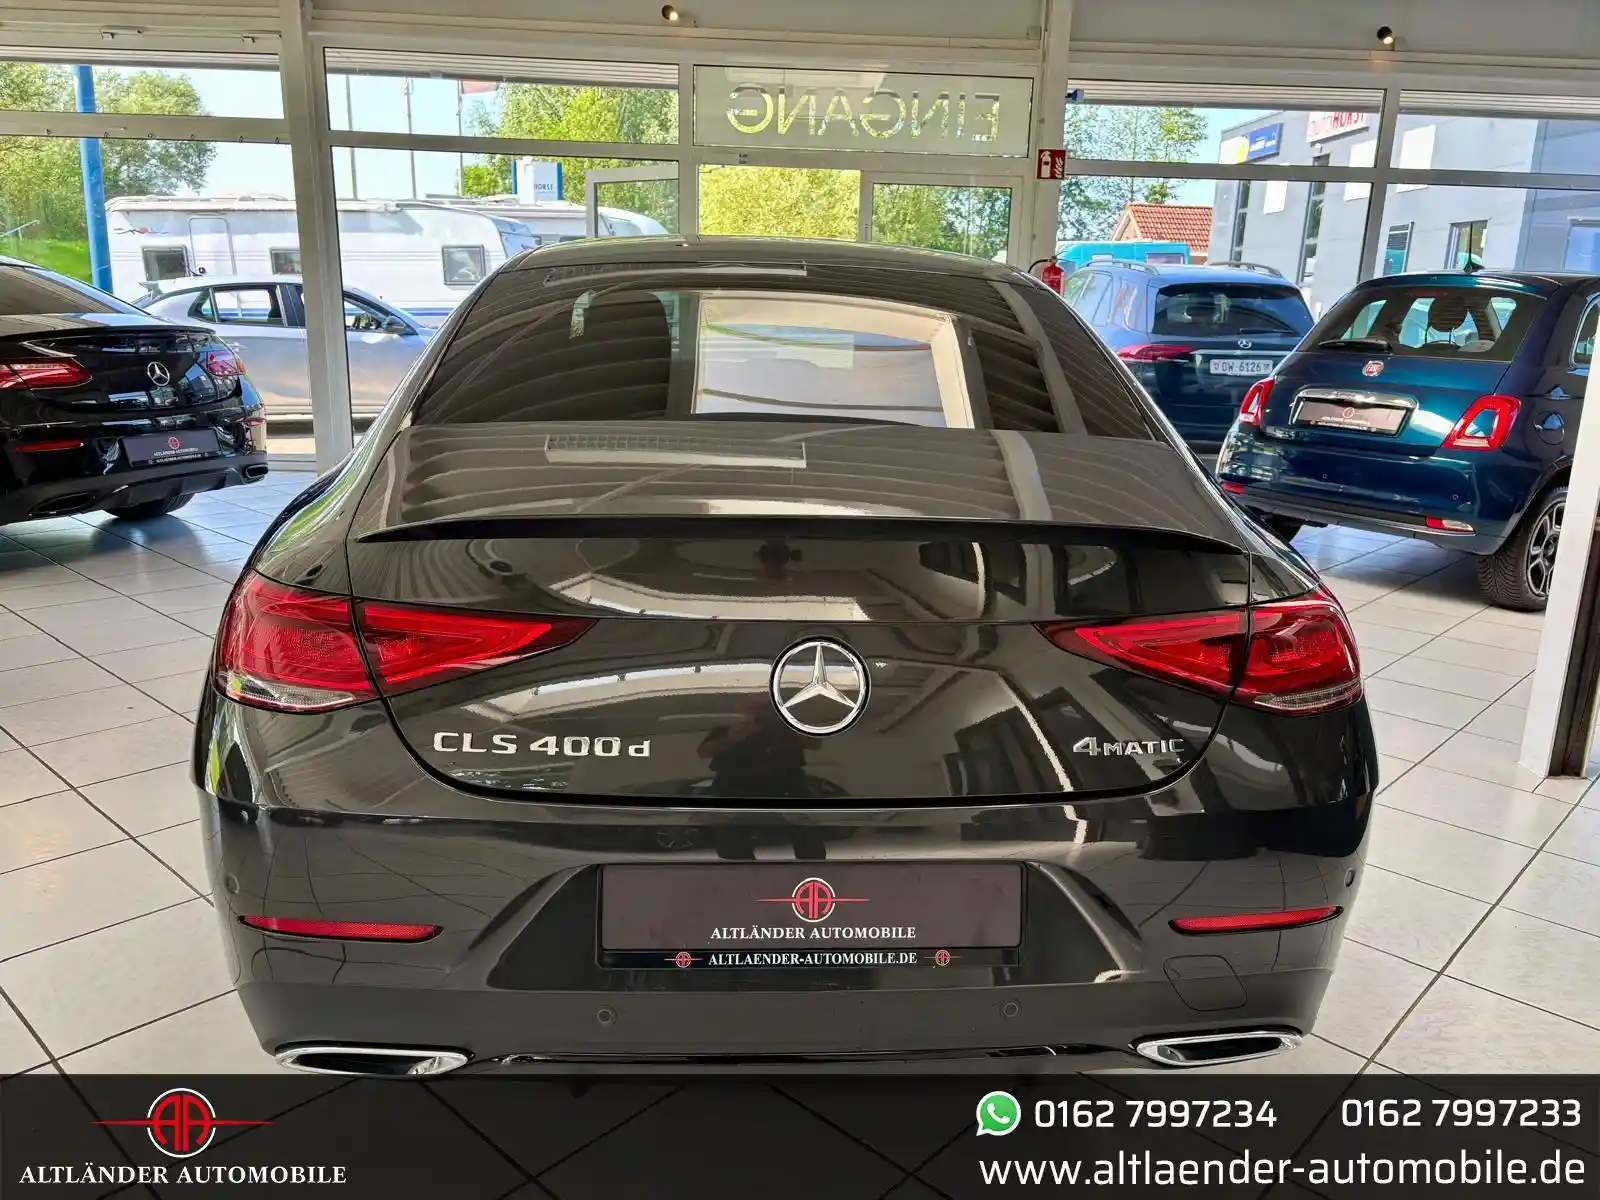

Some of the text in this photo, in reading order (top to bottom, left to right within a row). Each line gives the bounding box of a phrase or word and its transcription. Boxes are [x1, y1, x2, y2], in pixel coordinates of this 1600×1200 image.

[433, 732, 518, 755] CLS
[1073, 736, 1184, 756] 4MATIC
[710, 924, 916, 940] ALTLÄNDER AUTOMOBILE
[708, 952, 918, 966] ALTLAENDER-AUTOMOBILE.DE
